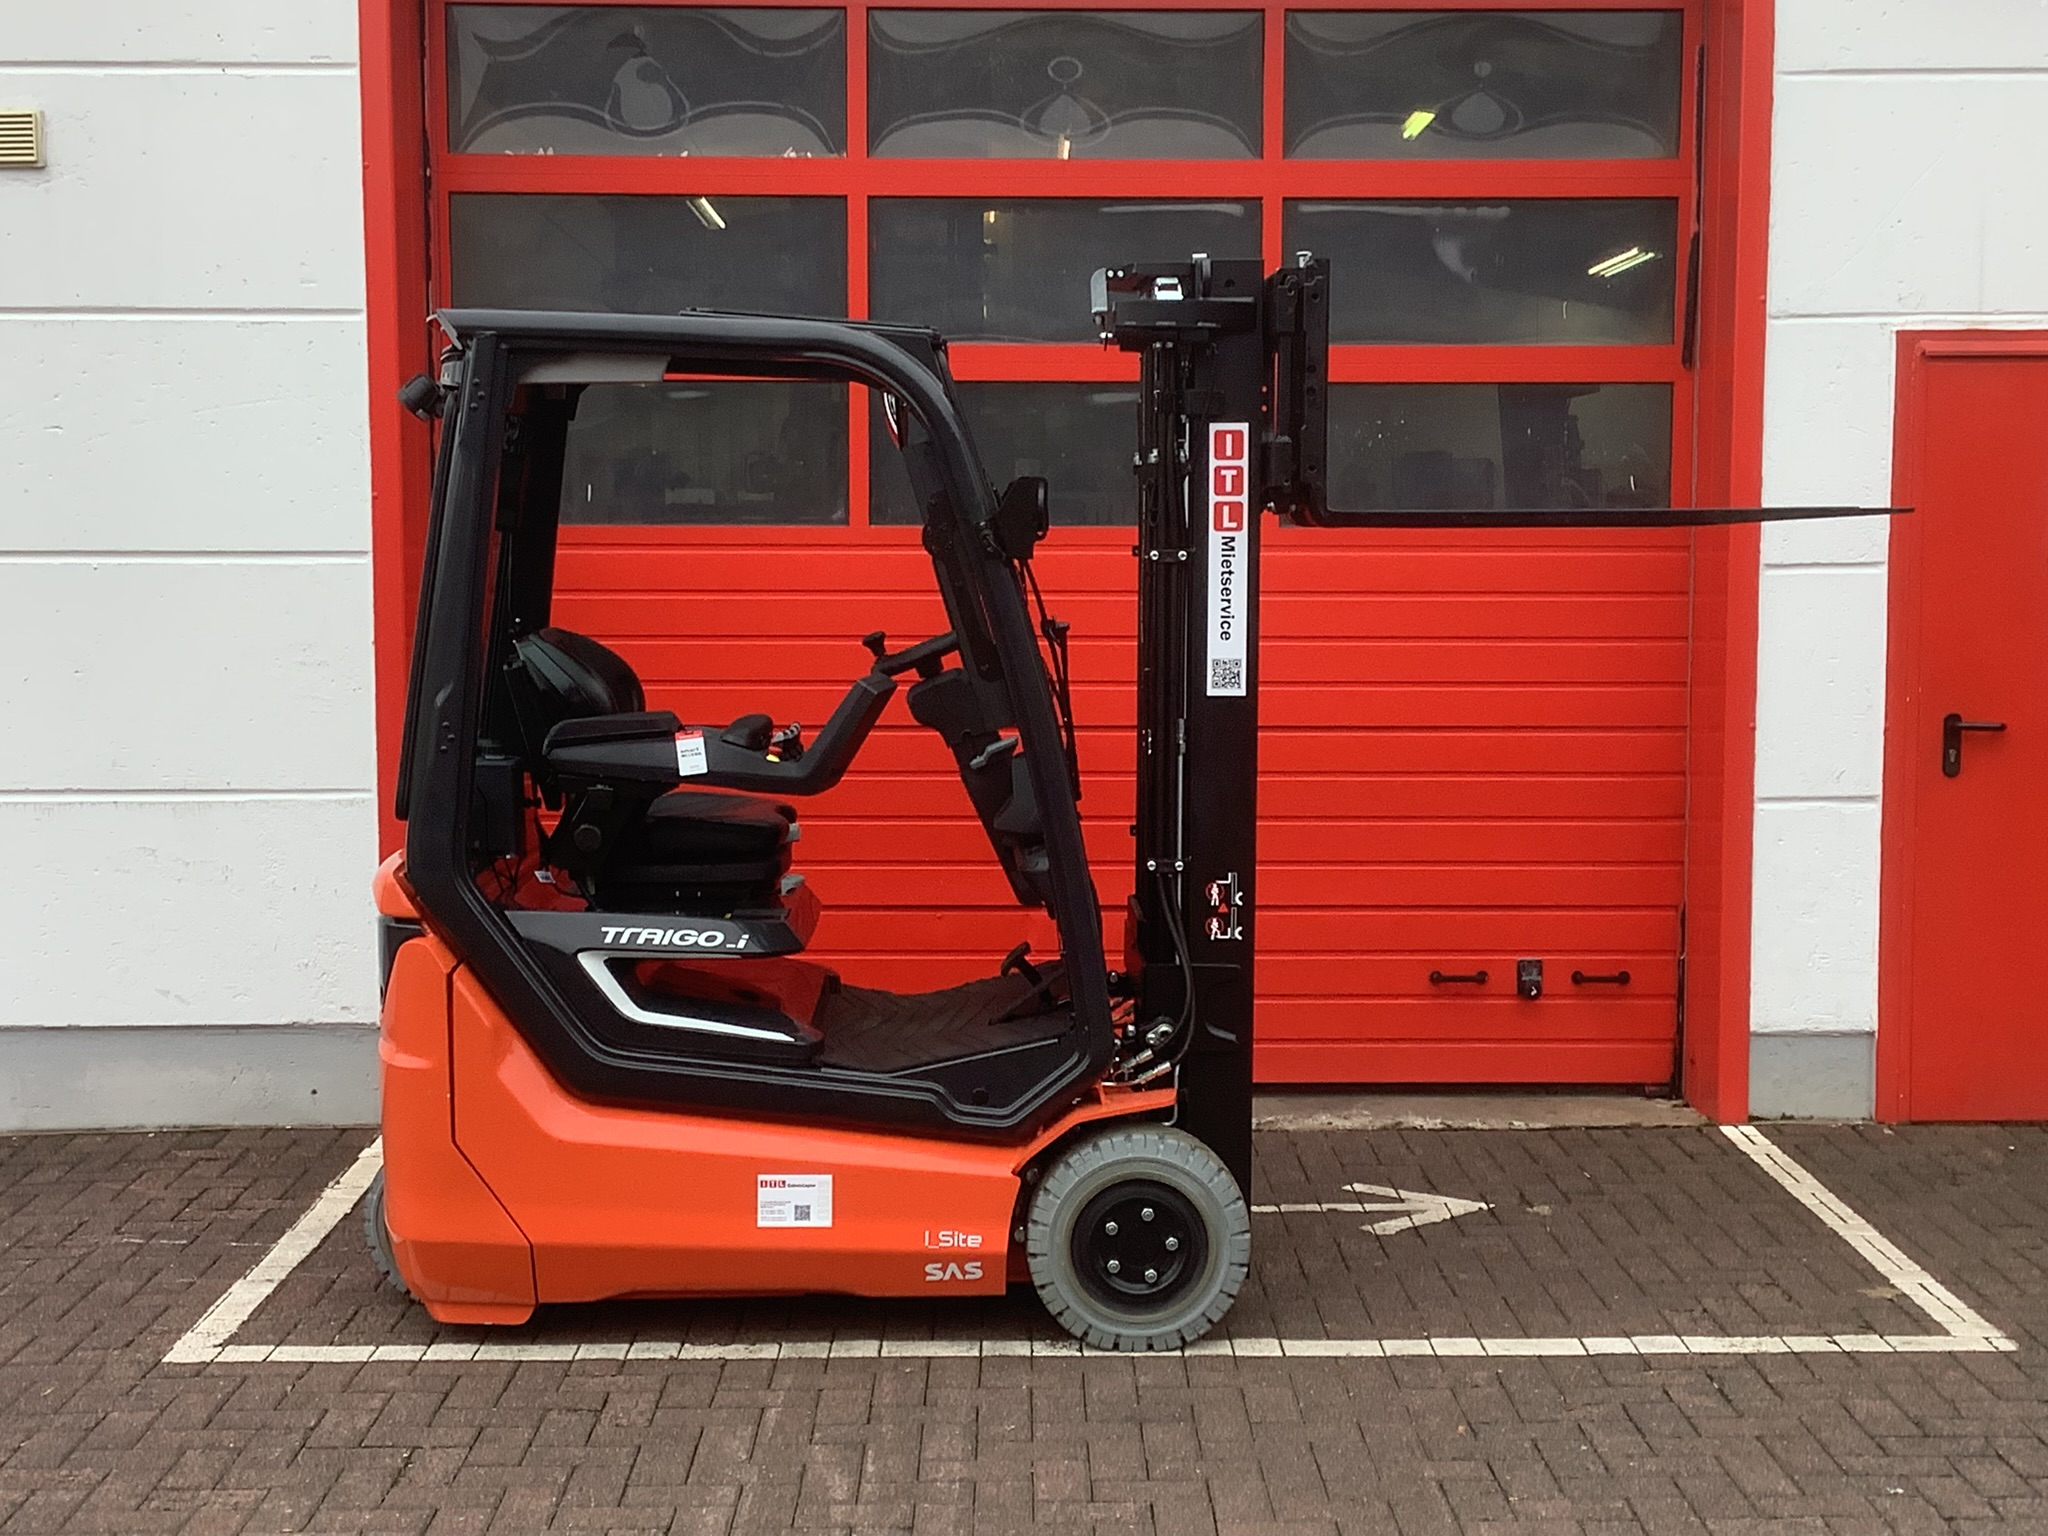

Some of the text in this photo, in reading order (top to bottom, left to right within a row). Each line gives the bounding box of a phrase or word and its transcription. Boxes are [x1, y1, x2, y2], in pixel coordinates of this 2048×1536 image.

[1217, 431, 1240, 641] ITL Mietservice
[924, 1262, 984, 1281] SAS
